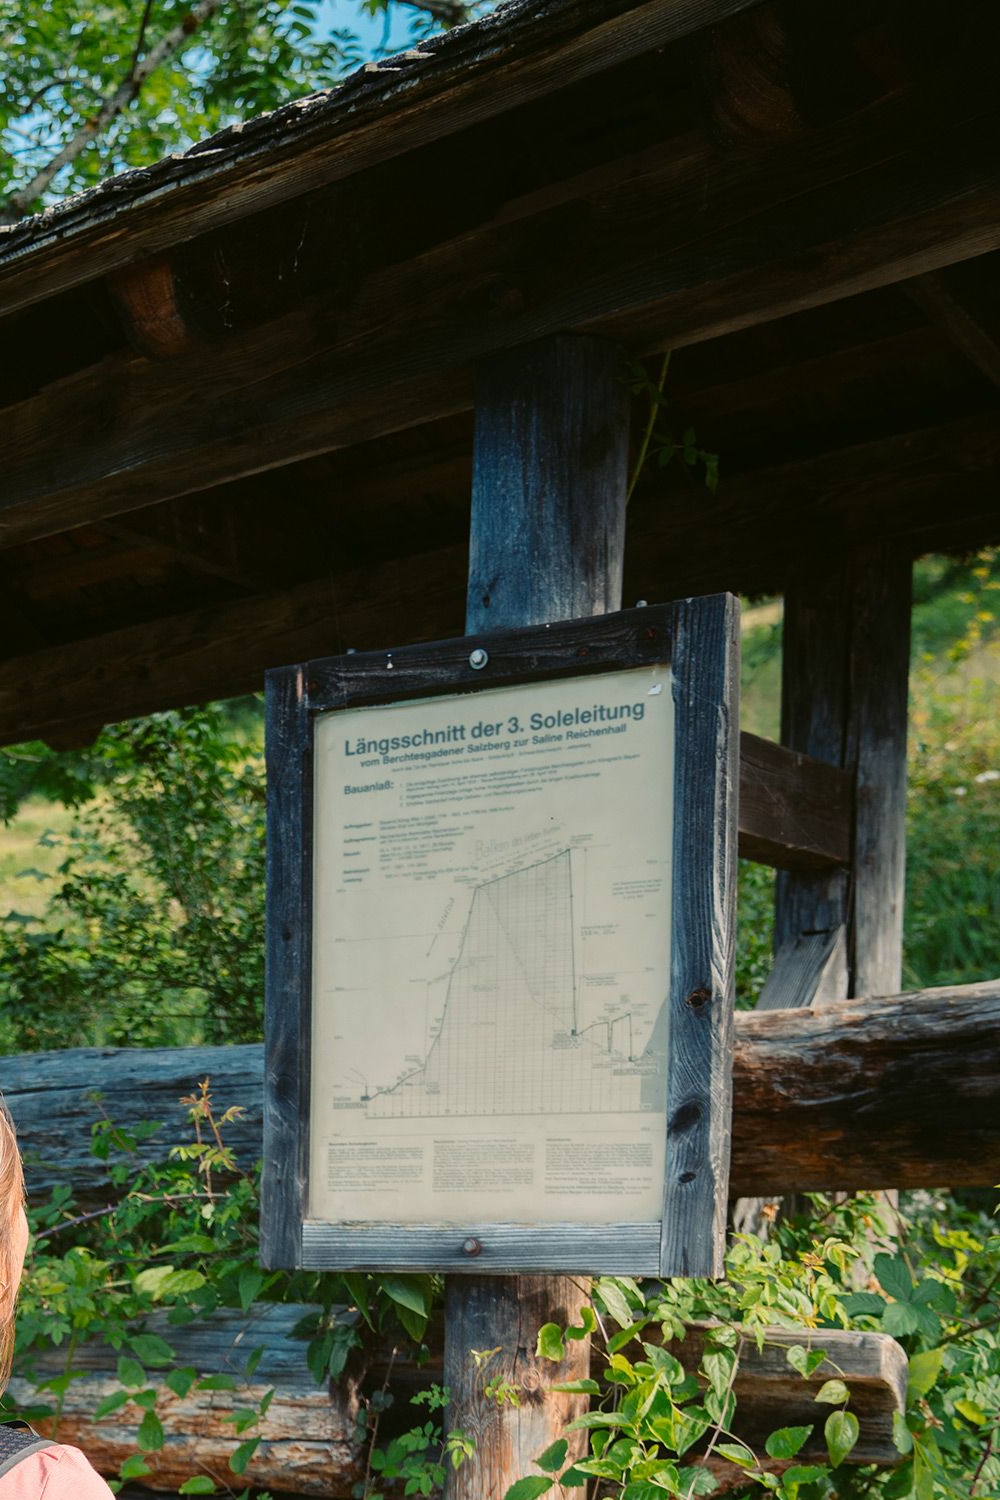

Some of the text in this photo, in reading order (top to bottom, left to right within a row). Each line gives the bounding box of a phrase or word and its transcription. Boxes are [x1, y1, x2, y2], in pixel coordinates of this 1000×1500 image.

[344, 702, 645, 757] Längsschnitt der 3. Soleleitung
[360, 758, 381, 768] vom
[382, 747, 464, 766] Berchtesgadener
[467, 739, 511, 754] Salzberg
[513, 738, 529, 748] zur
[532, 731, 563, 745] Saline
[566, 723, 627, 741] Reichenhall
[343, 780, 394, 796] Bauanlaß:
